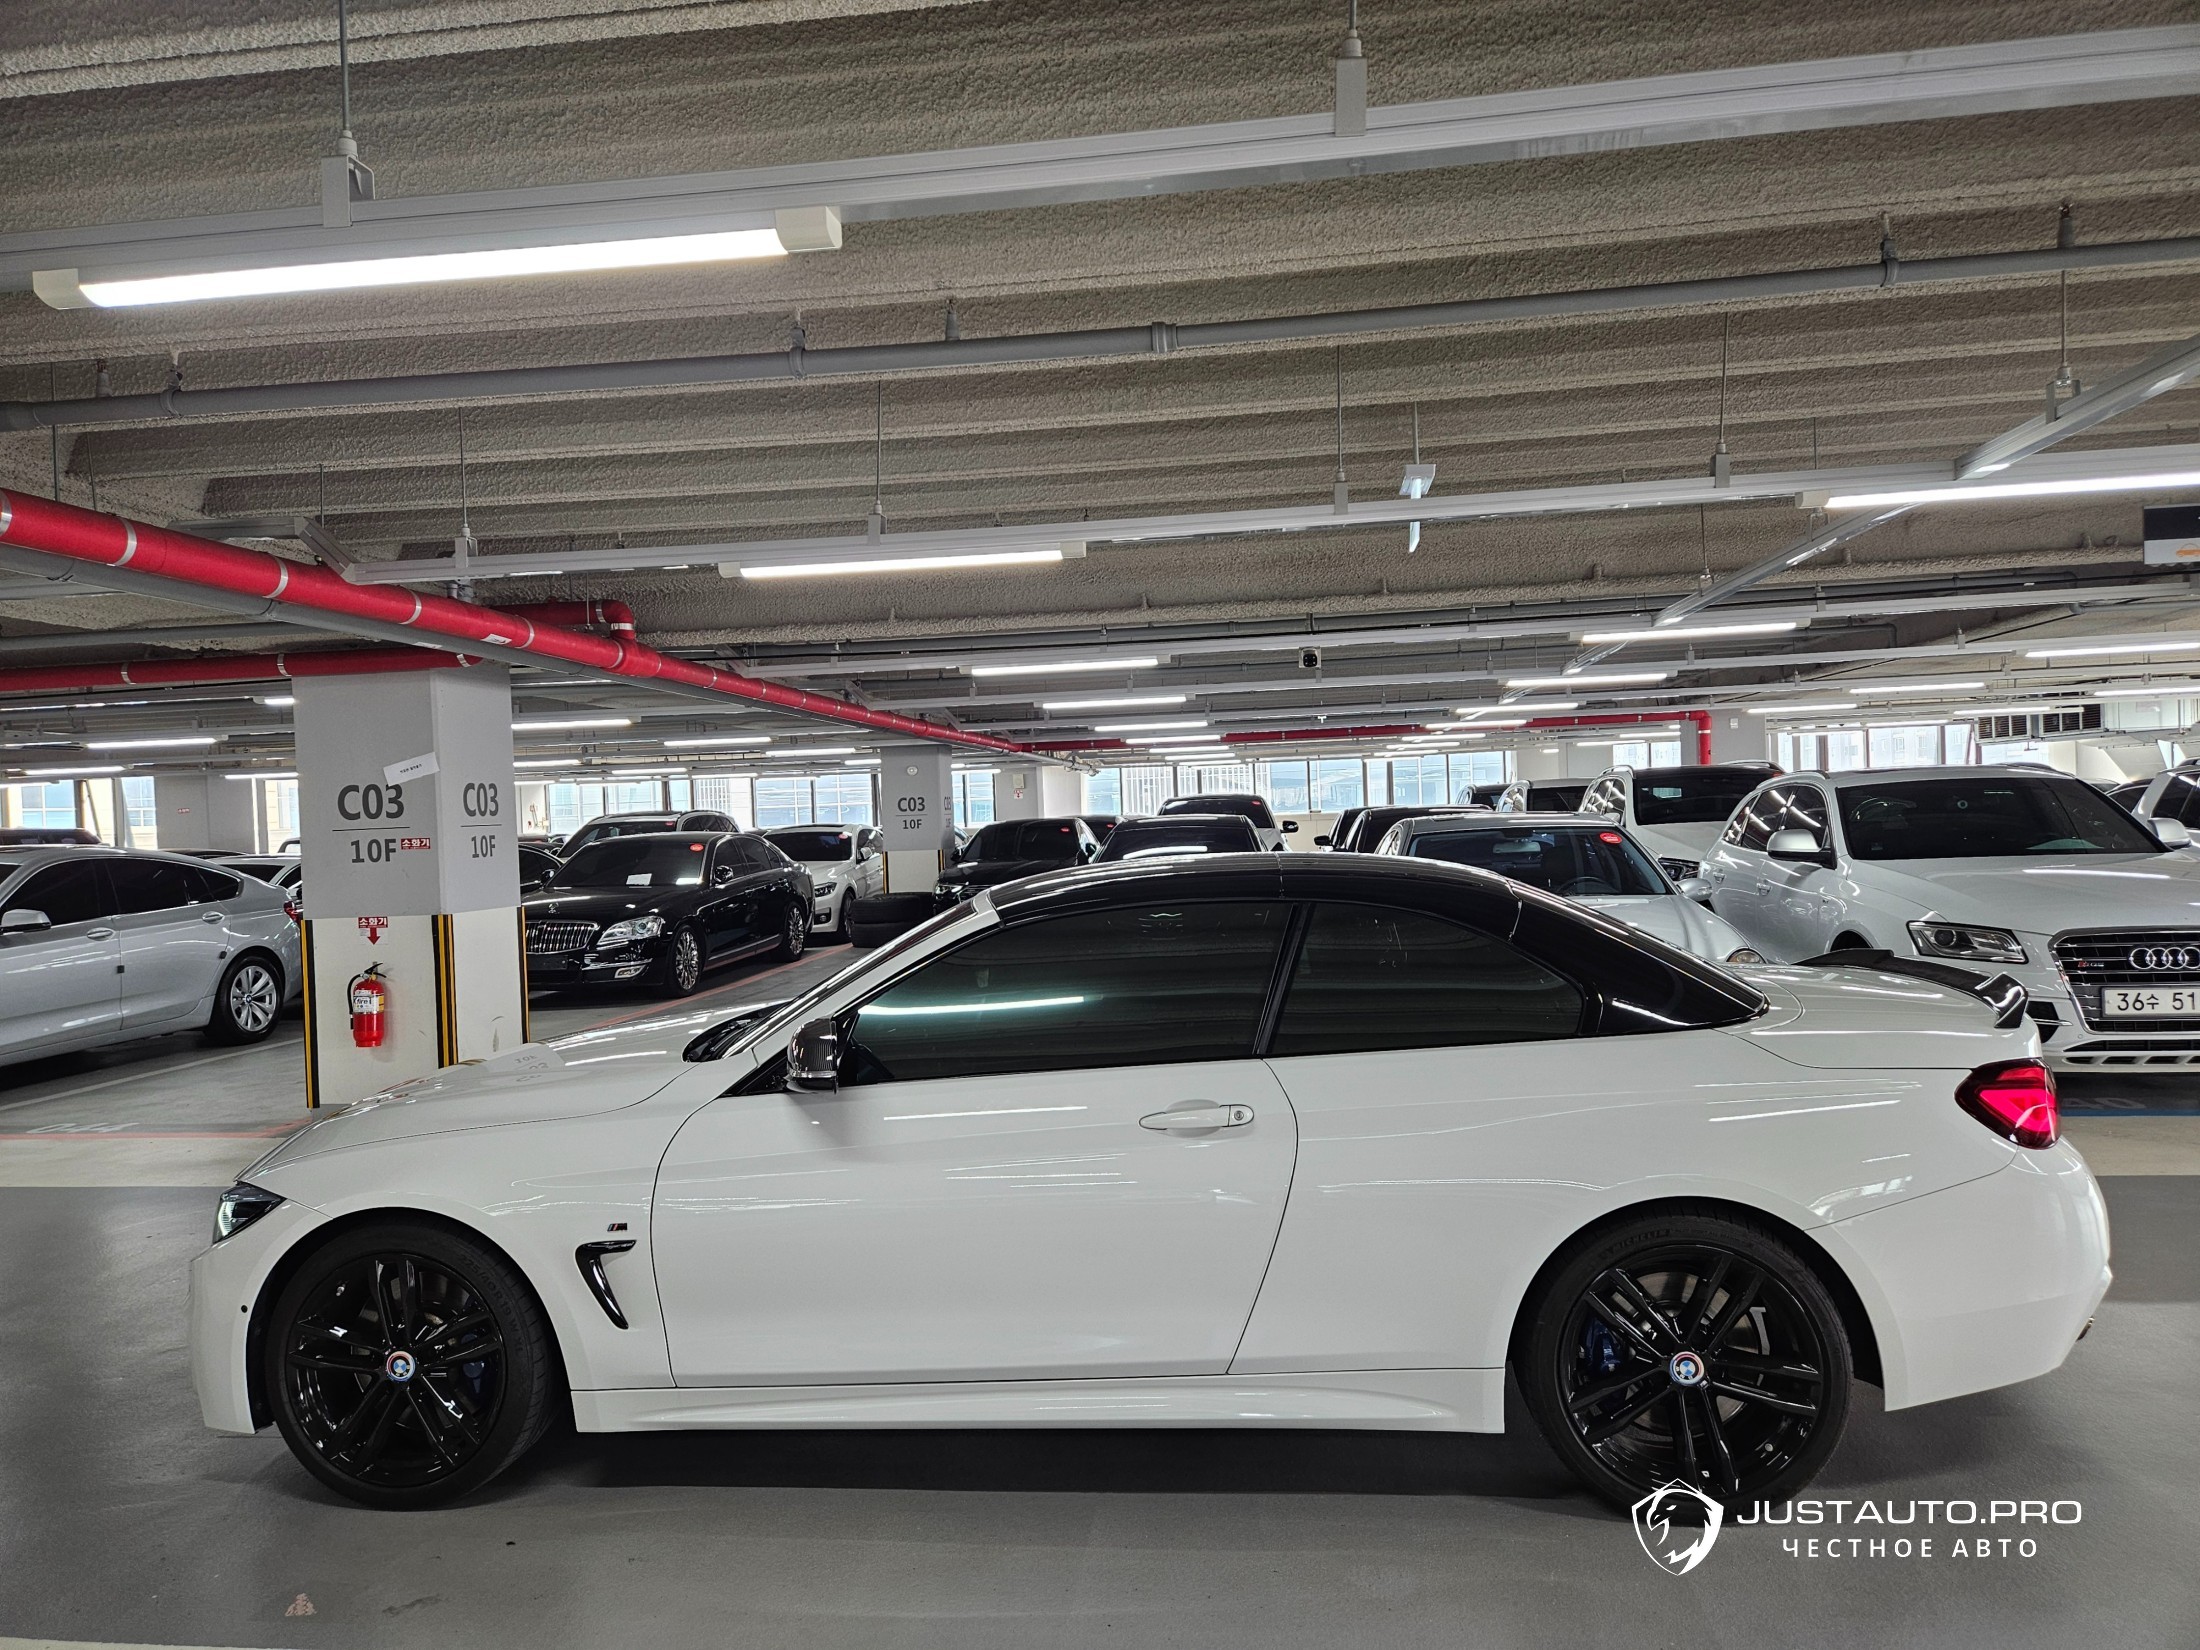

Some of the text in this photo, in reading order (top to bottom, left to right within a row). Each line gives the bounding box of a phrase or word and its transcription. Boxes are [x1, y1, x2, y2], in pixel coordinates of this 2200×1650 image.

[337, 783, 405, 821] C03
[462, 782, 499, 818] C03
[897, 796, 926, 812] C03
[902, 818, 922, 830] 10F
[350, 838, 397, 863] 10F
[402, 838, 430, 847] 소화기
[471, 834, 496, 859] 10F
[359, 917, 387, 926] 소화기
[2117, 991, 2196, 1011] 36수 51
